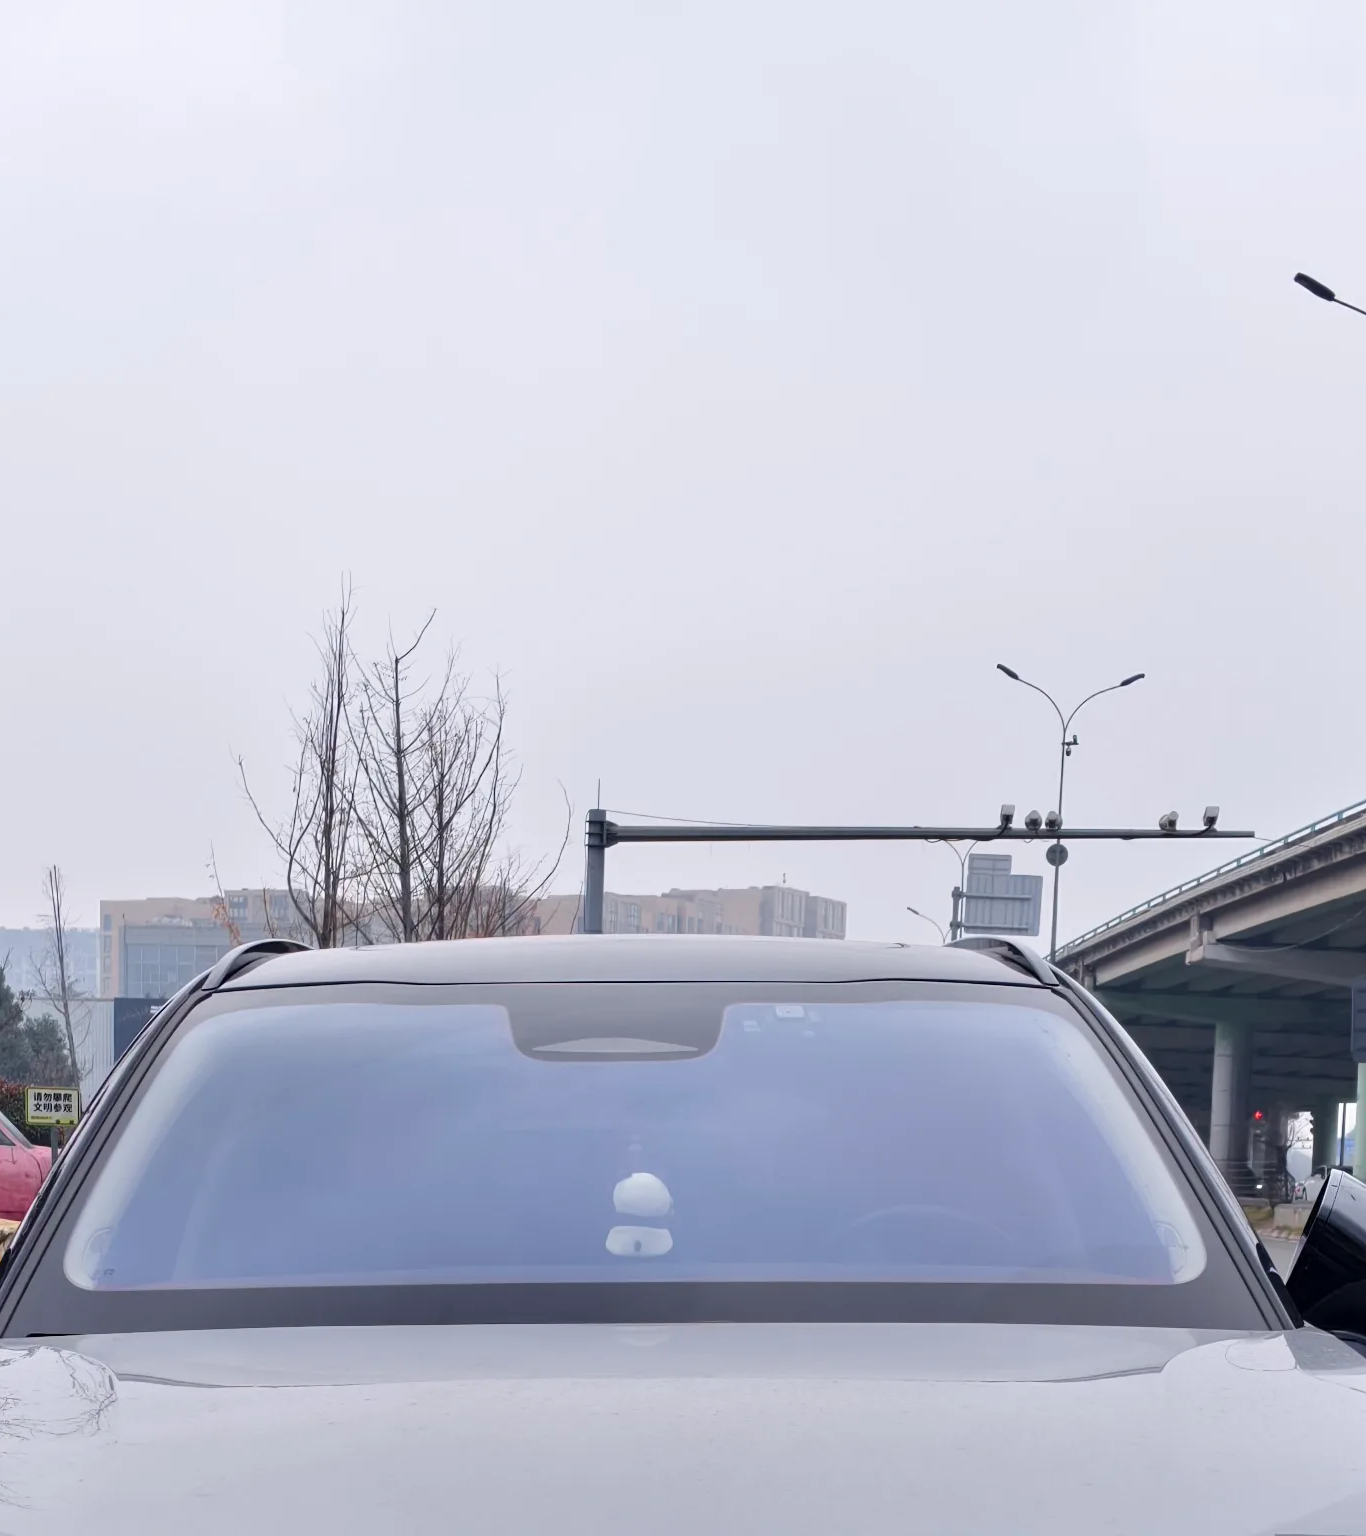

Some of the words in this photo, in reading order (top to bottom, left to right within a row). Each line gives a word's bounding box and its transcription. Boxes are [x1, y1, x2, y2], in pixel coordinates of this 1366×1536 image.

[33, 1092, 73, 1103] 请勿攀爬
[33, 1102, 73, 1113] 文明参观
